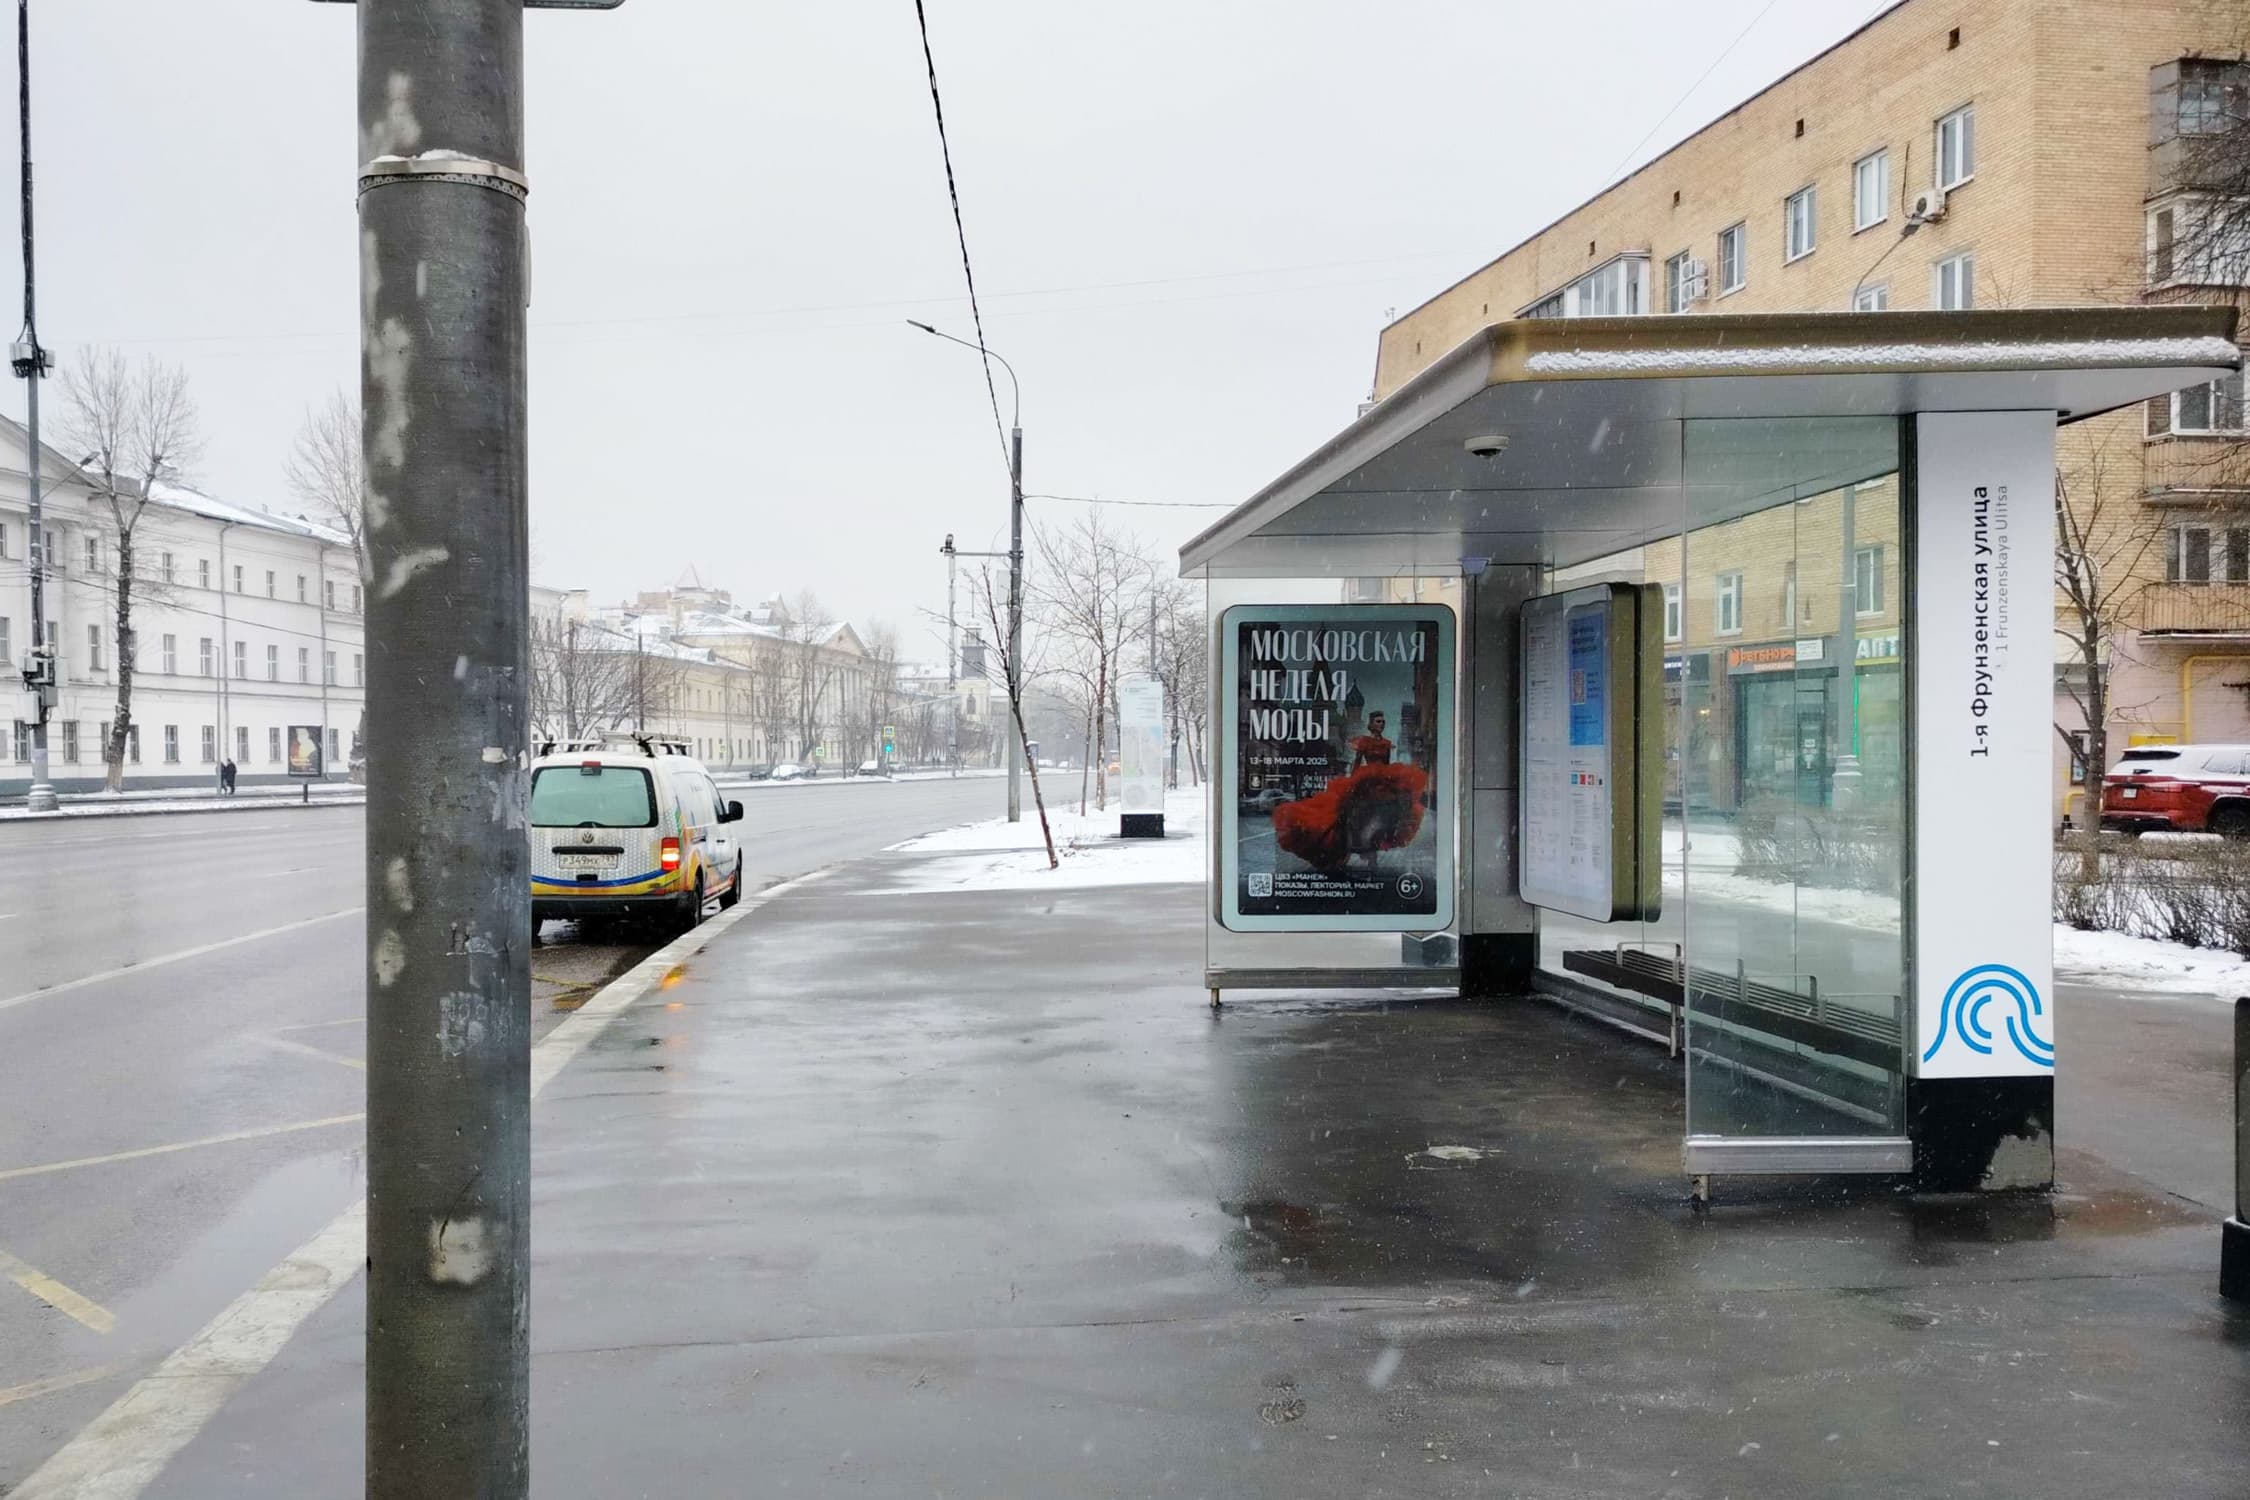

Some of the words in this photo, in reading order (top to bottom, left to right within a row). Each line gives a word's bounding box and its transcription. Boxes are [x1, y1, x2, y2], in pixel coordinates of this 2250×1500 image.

[1973, 485, 1993, 556] улица
[1995, 485, 2009, 531] Ulitsa
[1995, 535, 2011, 639] Frunzenskaya
[1250, 629, 1426, 663] МОСКОВСКАЯ
[1970, 562, 1993, 717] Фрунзенская
[1250, 670, 1348, 704] НЕДЕЛЯ
[1249, 708, 1330, 743] МОДЫ
[1970, 725, 1989, 758] 1-я
[1274, 757, 1305, 766] МАРТА
[1306, 757, 1329, 766] 2025
[1400, 879, 1418, 893] 6+
